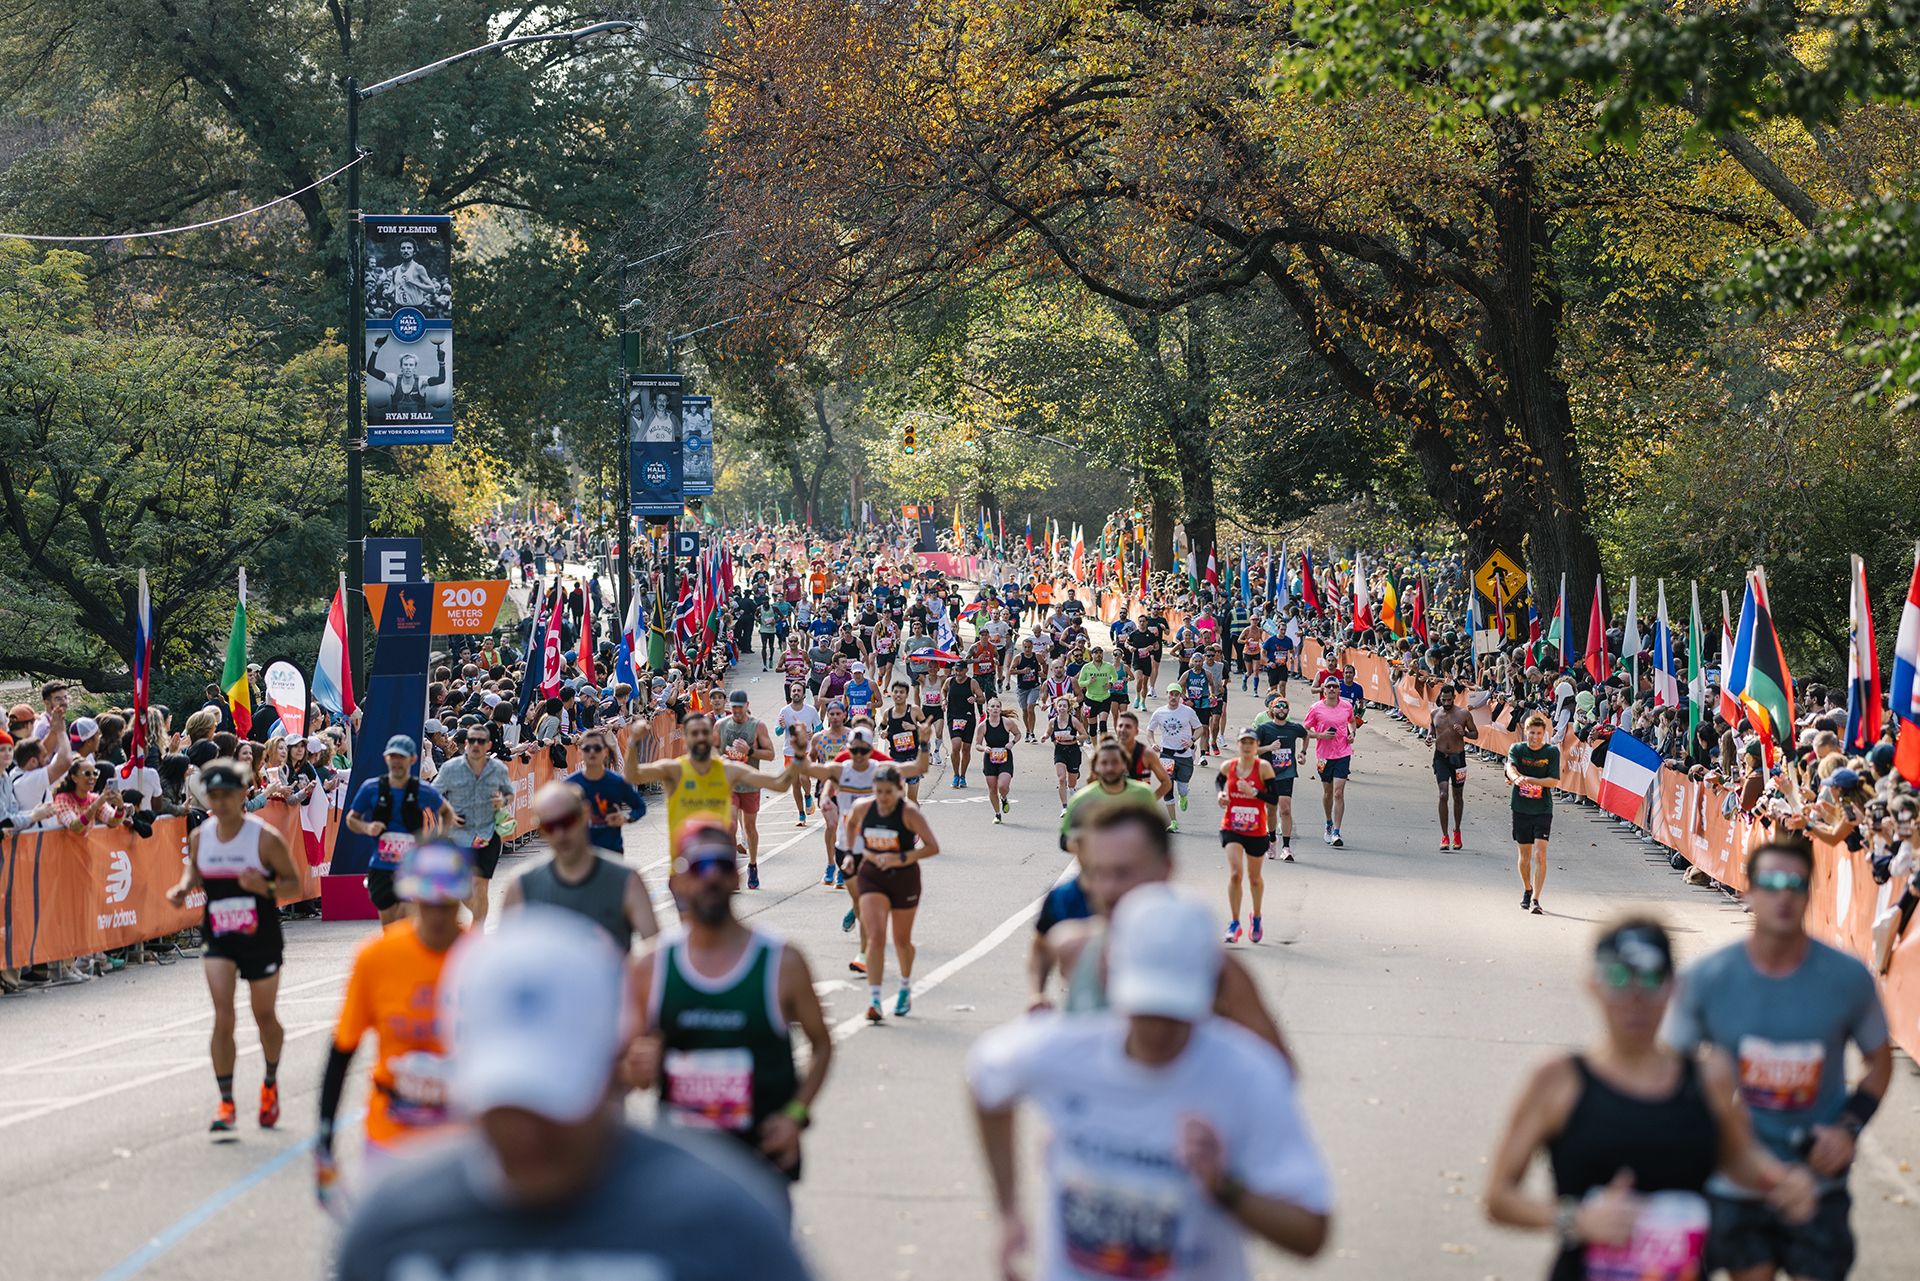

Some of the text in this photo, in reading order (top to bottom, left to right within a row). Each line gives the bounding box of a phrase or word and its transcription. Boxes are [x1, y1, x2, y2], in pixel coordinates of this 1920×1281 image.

[411, 412, 433, 420] HALL
[681, 537, 695, 552] D
[380, 551, 407, 582] E
[441, 588, 487, 607] 200
[447, 609, 483, 618] METERS
[452, 618, 480, 627] TO GO
[97, 908, 137, 929] new balance
